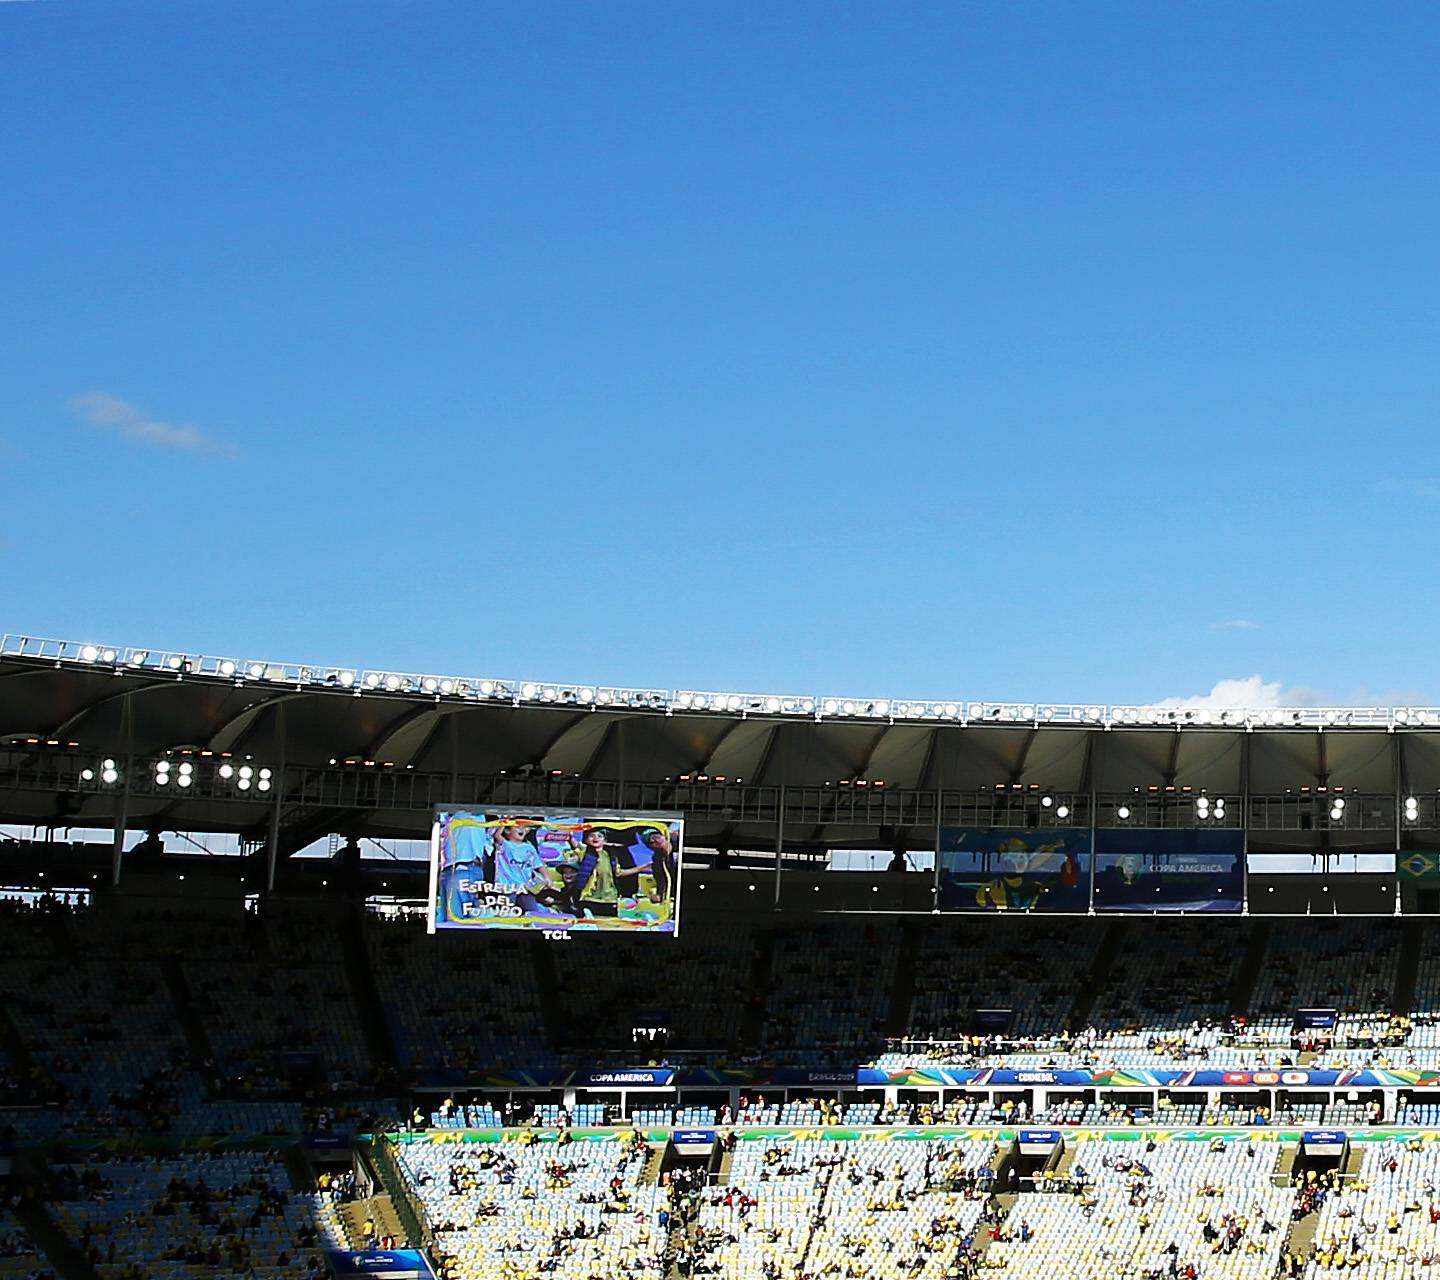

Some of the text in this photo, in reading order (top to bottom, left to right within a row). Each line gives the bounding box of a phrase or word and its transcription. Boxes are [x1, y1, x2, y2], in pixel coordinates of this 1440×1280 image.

[1150, 864, 1223, 872] COPA AMERICA
[485, 895, 515, 907] DEL
[542, 930, 571, 940] TCL
[590, 1073, 654, 1083] COPA AMERICA
